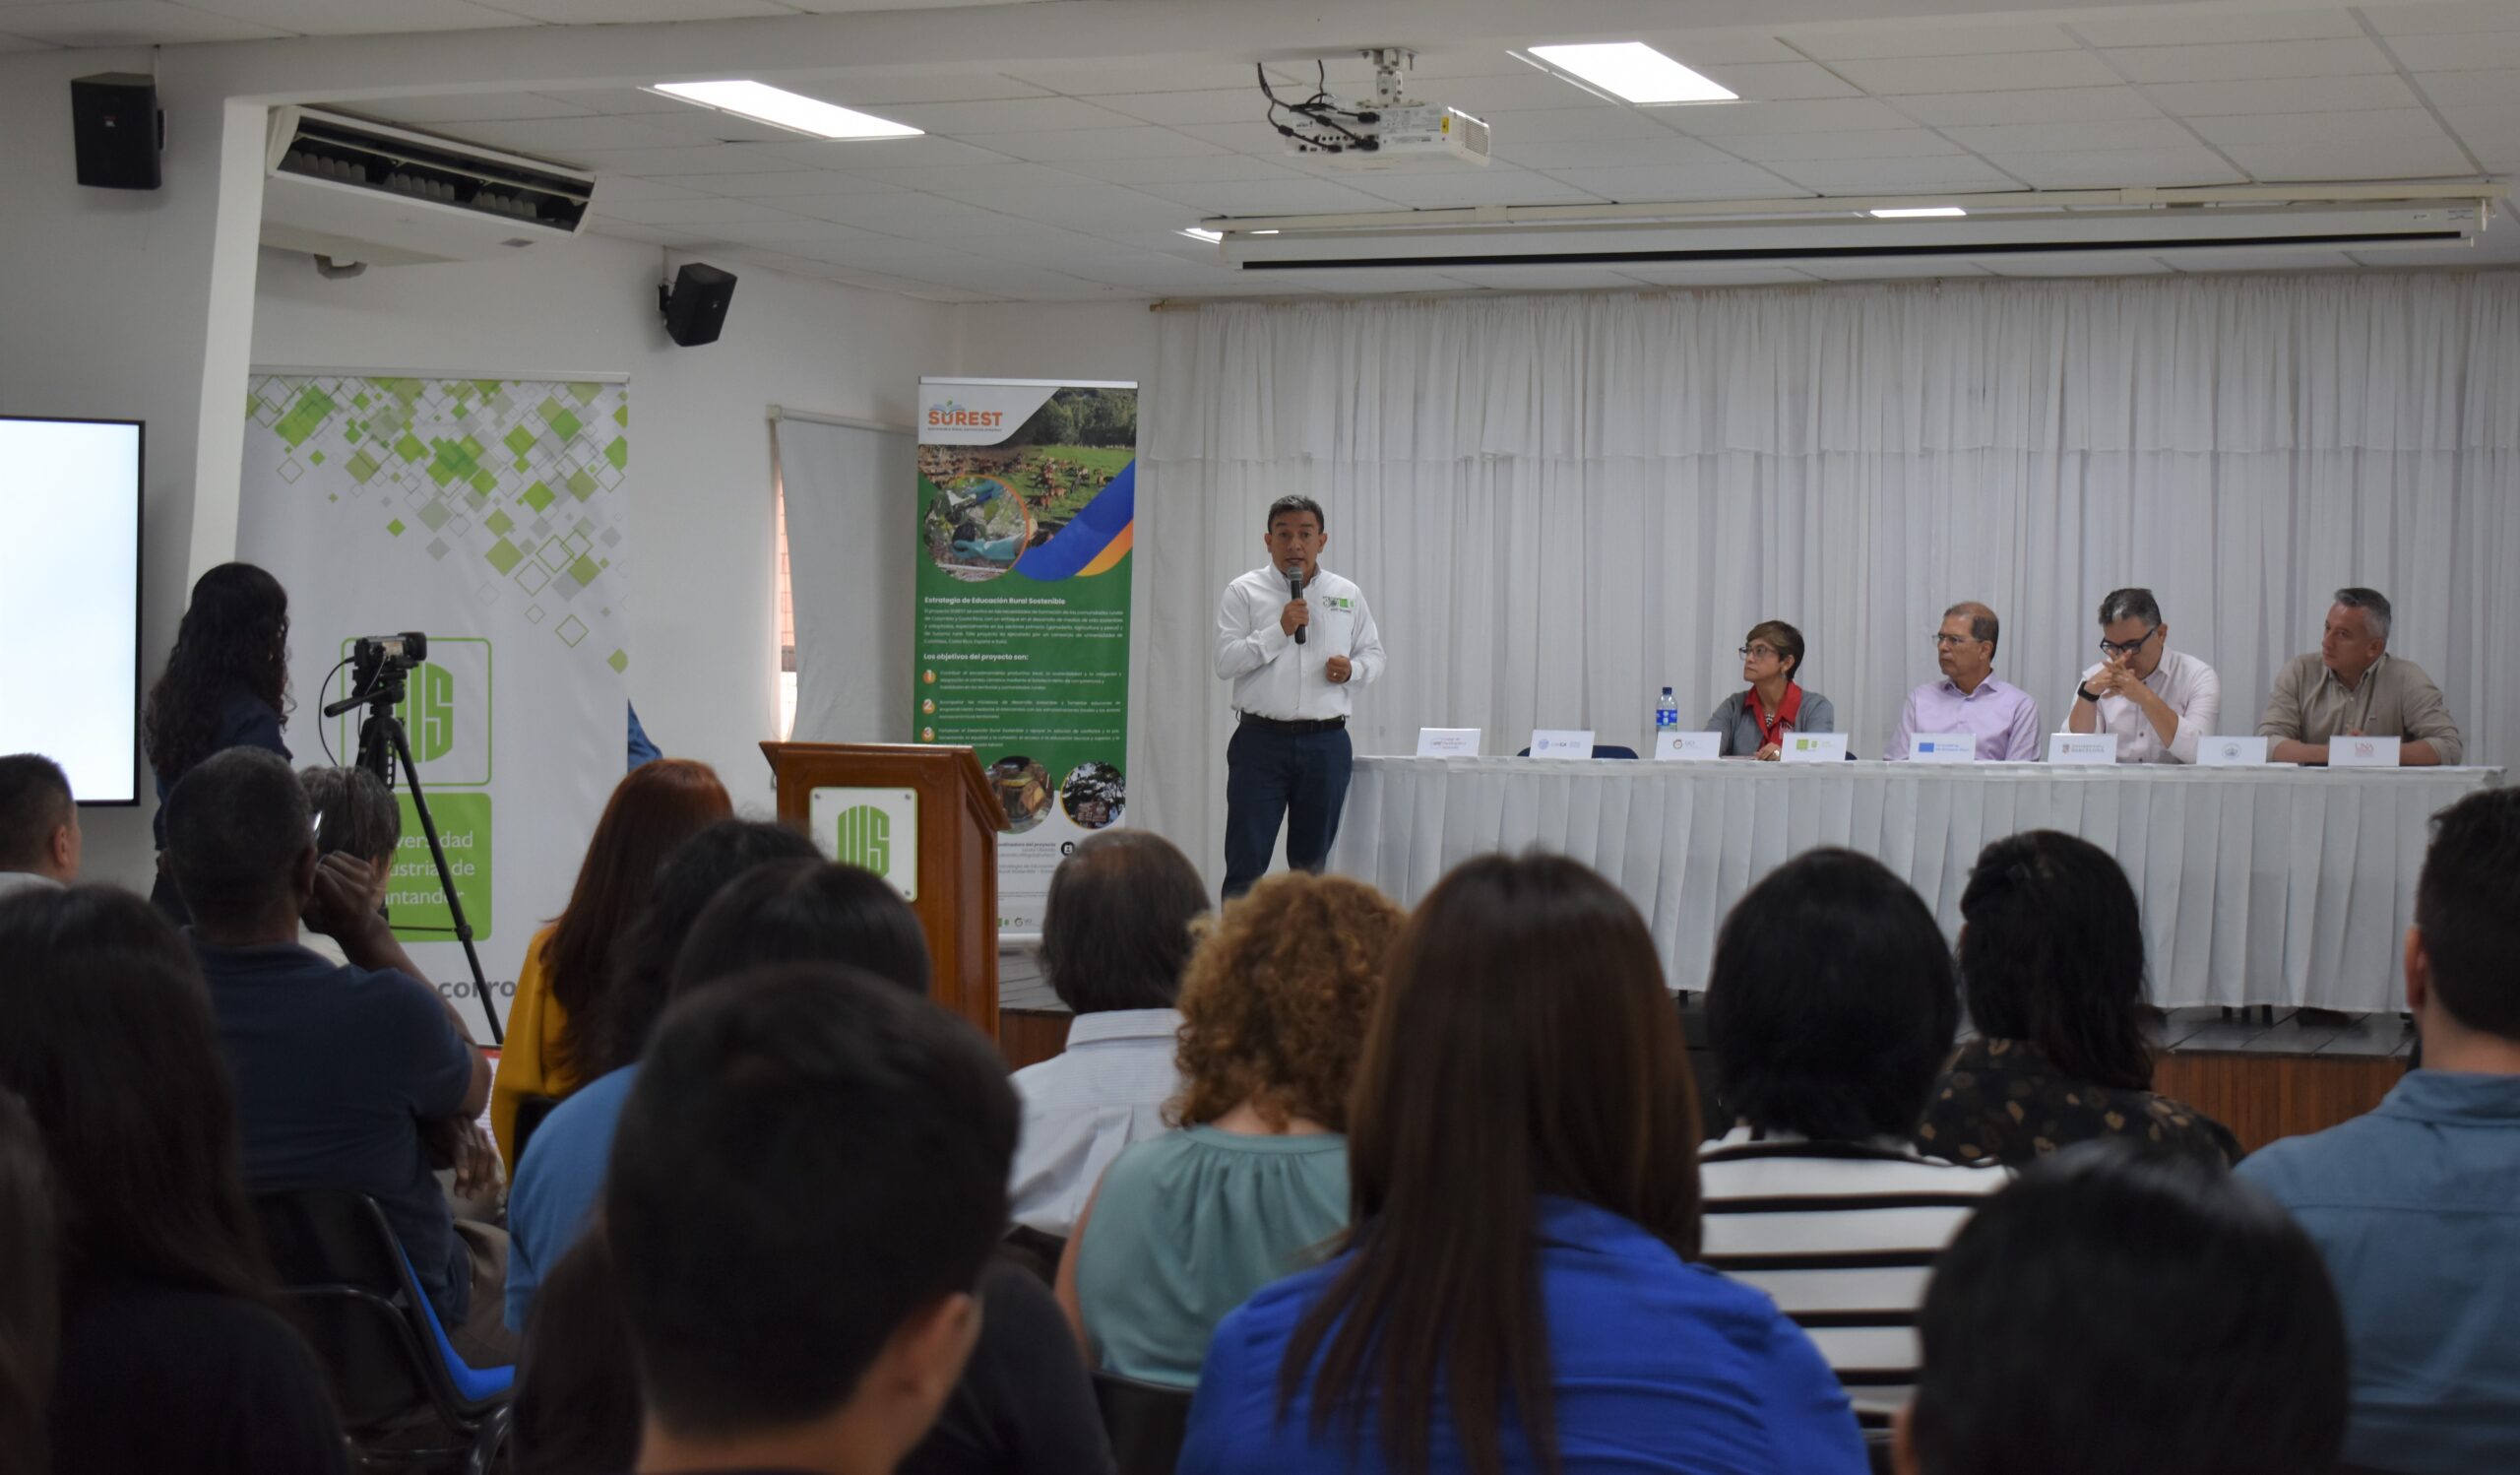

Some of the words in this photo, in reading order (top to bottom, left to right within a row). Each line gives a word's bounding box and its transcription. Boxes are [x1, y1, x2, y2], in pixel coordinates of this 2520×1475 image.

[927, 411, 1003, 425] SUREST
[924, 597, 961, 606] Estrategia
[453, 859, 475, 876] de
